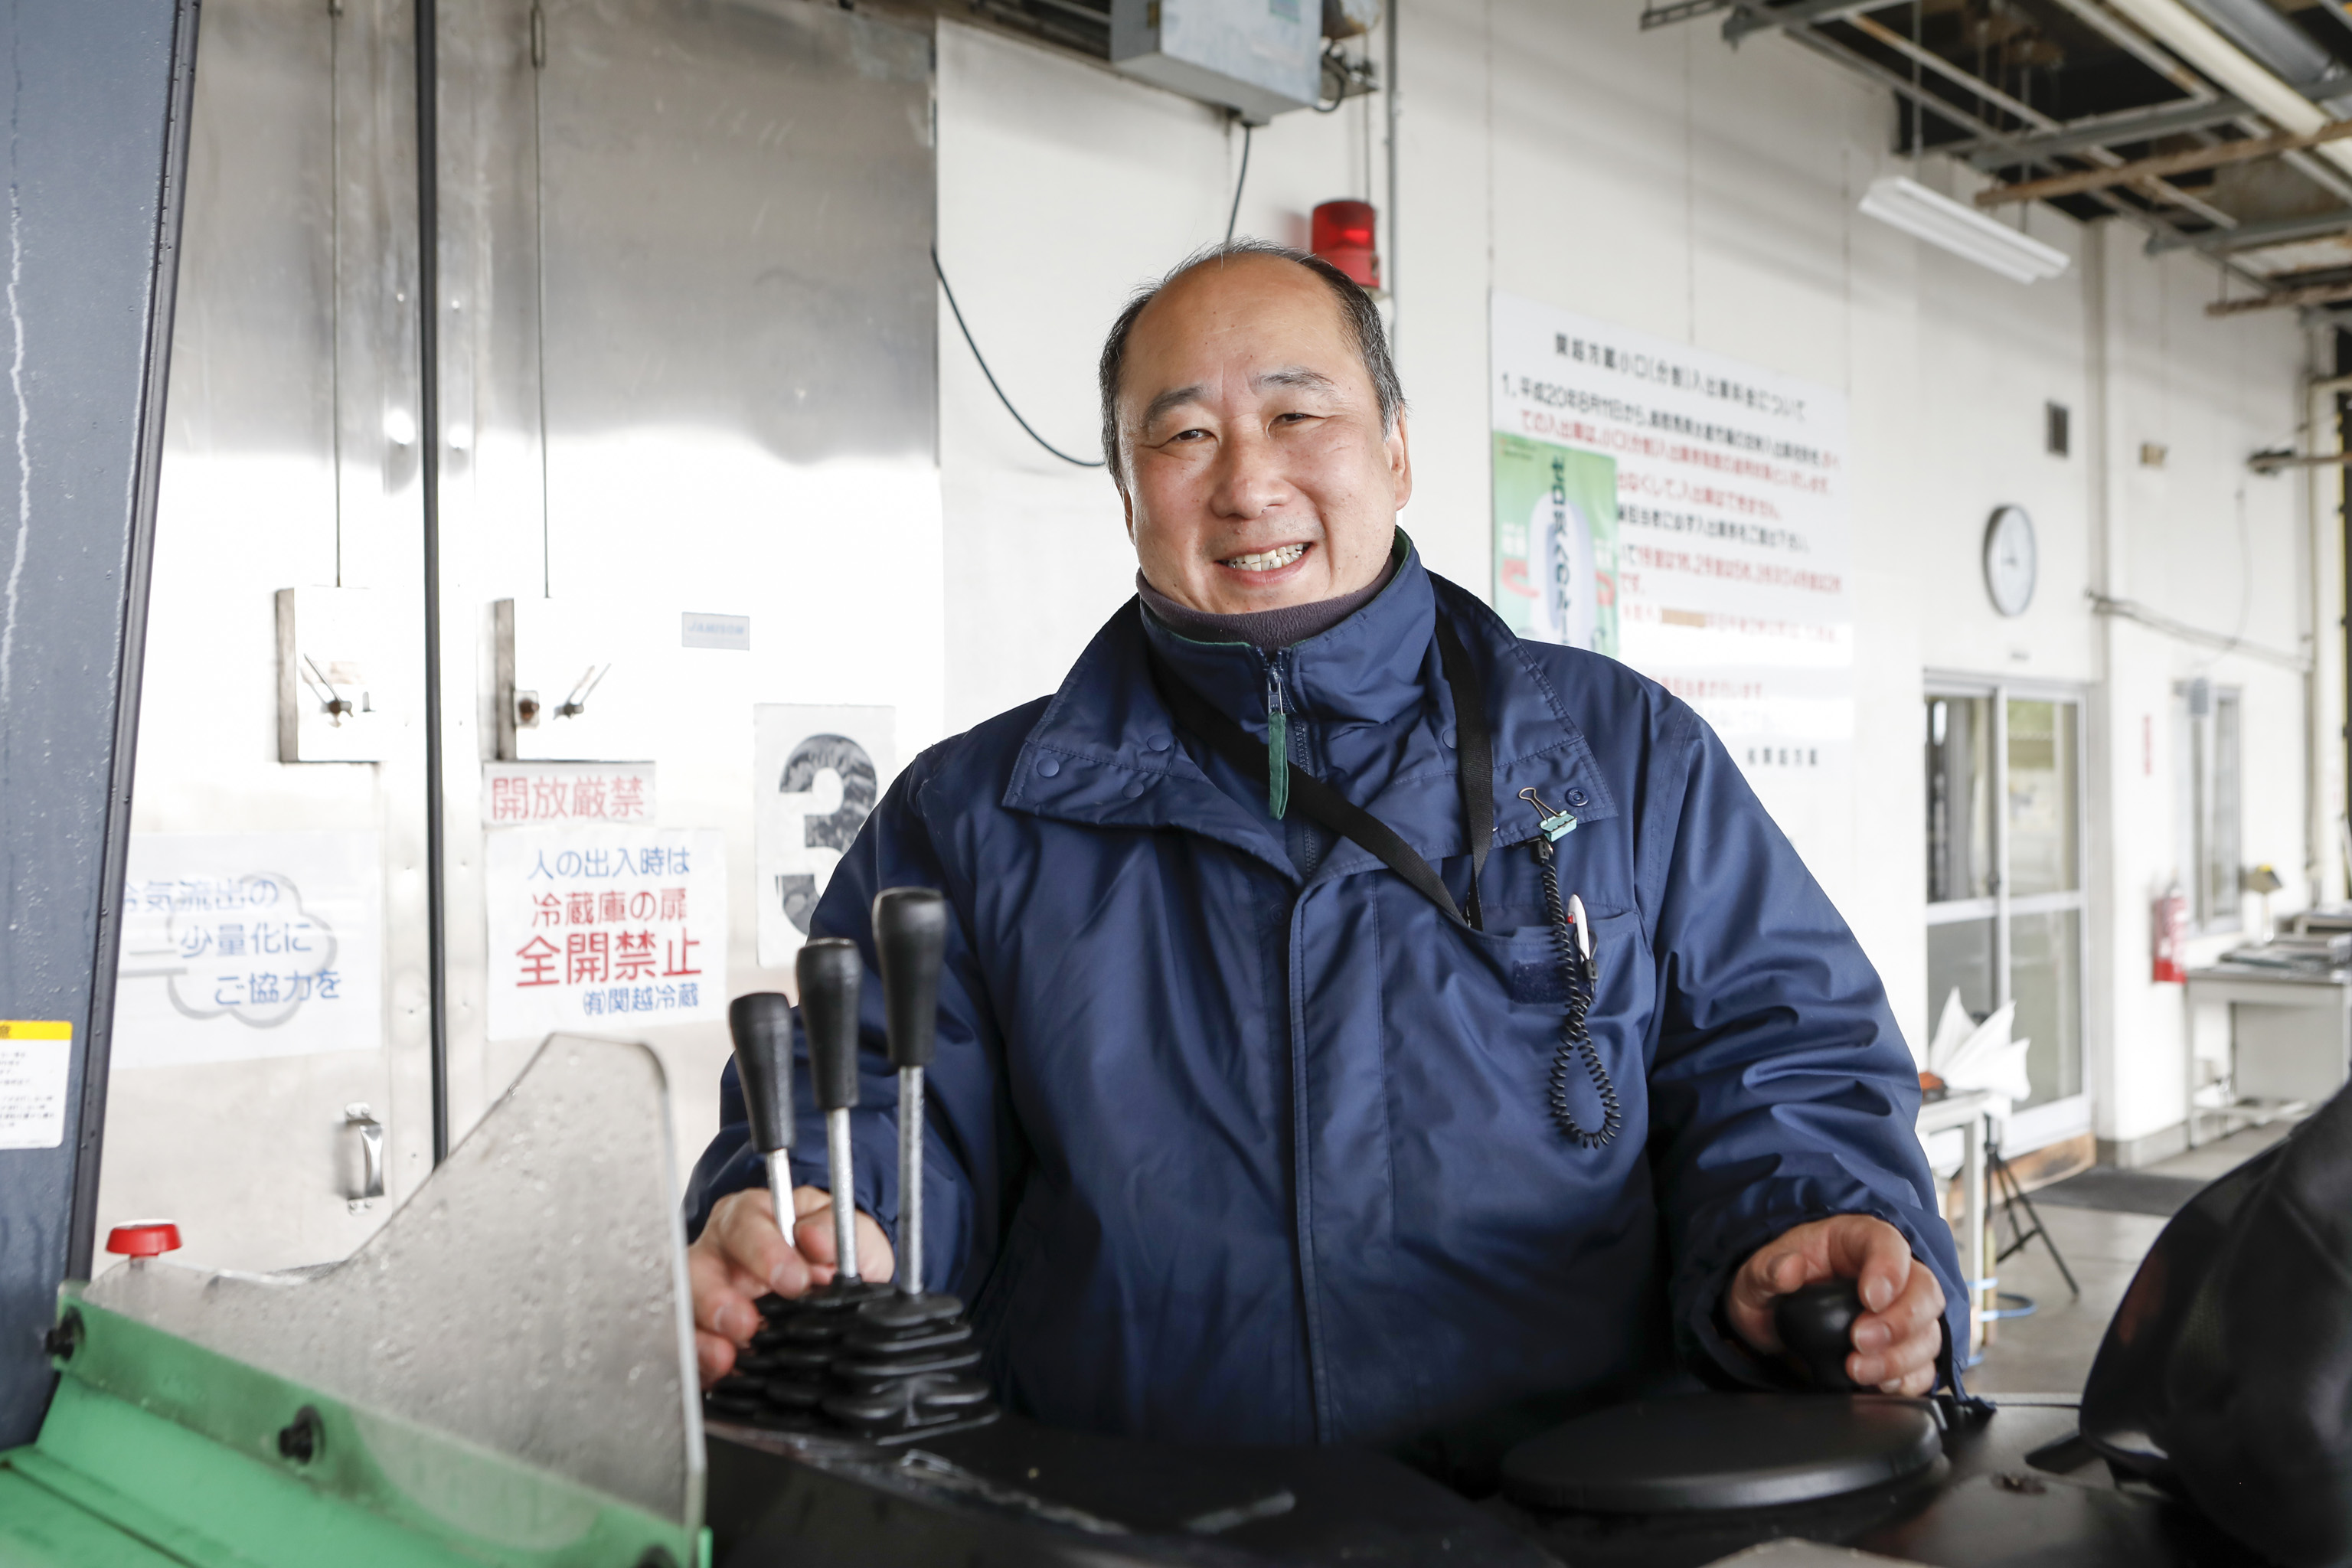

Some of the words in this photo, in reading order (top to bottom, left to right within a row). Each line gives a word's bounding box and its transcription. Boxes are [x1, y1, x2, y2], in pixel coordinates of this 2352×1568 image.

[1552, 456, 1571, 645] ゼロ災へのルー
[492, 775, 645, 821] 開放厳禁
[775, 733, 877, 936] 3
[527, 845, 691, 880] 人の出入時は
[531, 887, 688, 928] 冷蔵庫の扉
[180, 921, 312, 959] 少量化に
[515, 926, 703, 988] 全開禁止
[214, 966, 341, 1006] ご協力を
